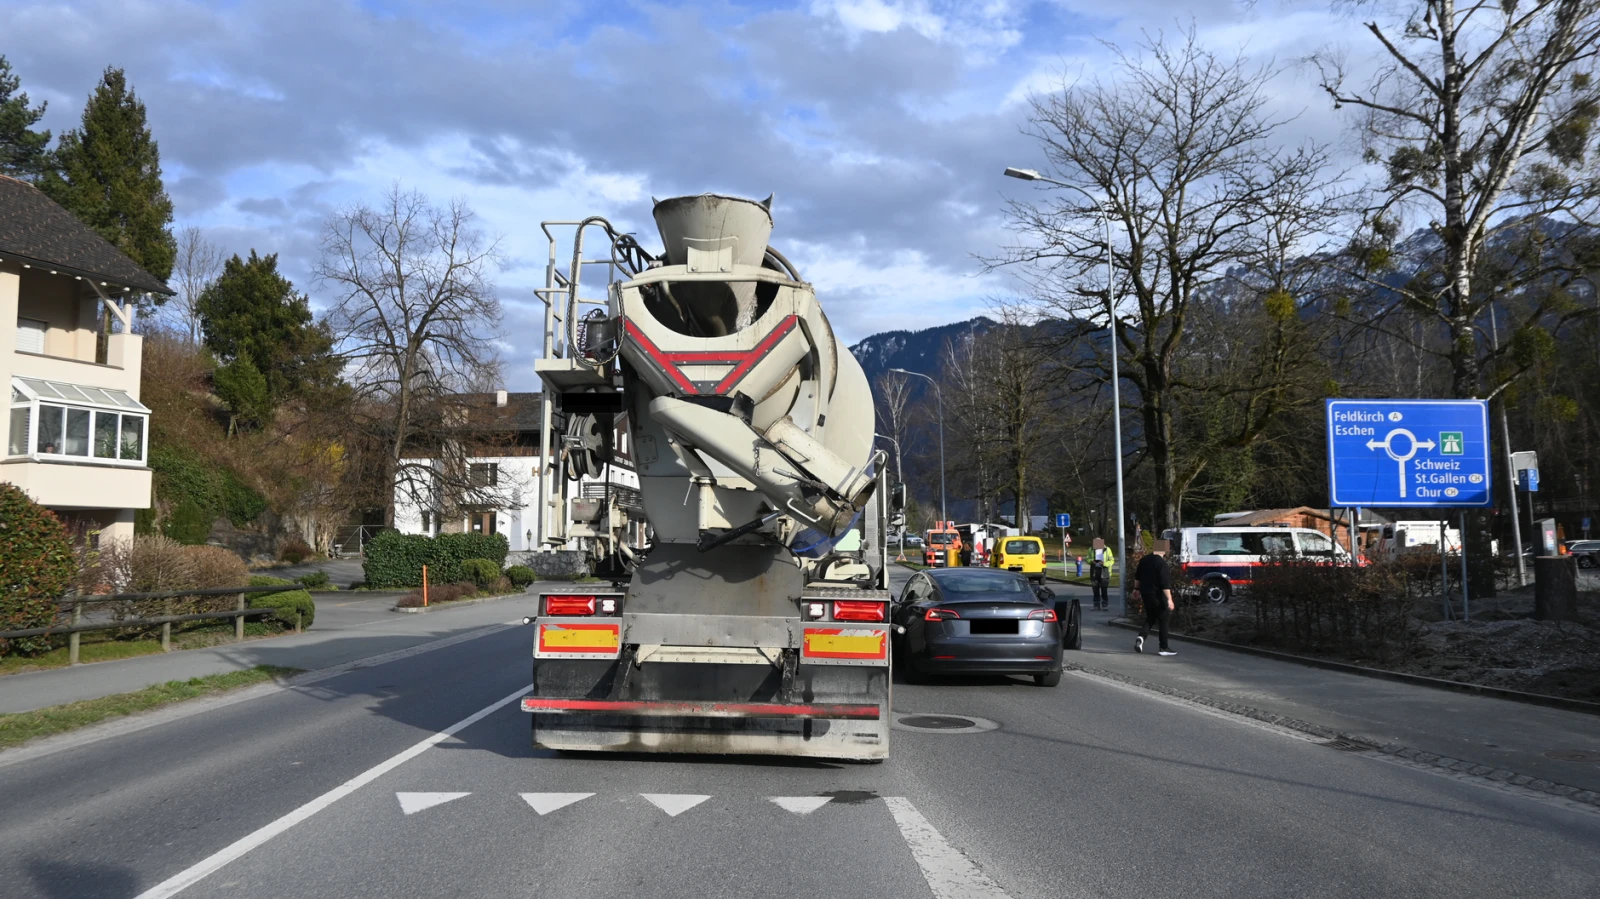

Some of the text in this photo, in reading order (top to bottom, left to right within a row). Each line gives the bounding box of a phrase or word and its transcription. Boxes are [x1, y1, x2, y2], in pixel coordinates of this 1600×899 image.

[1334, 410, 1399, 422] Feldkirch A
[1335, 425, 1375, 436] Eschen
[1414, 458, 1460, 470] Schweiz
[1415, 473, 1481, 484] St.Gallen CH
[1416, 486, 1456, 498] Chur CH
